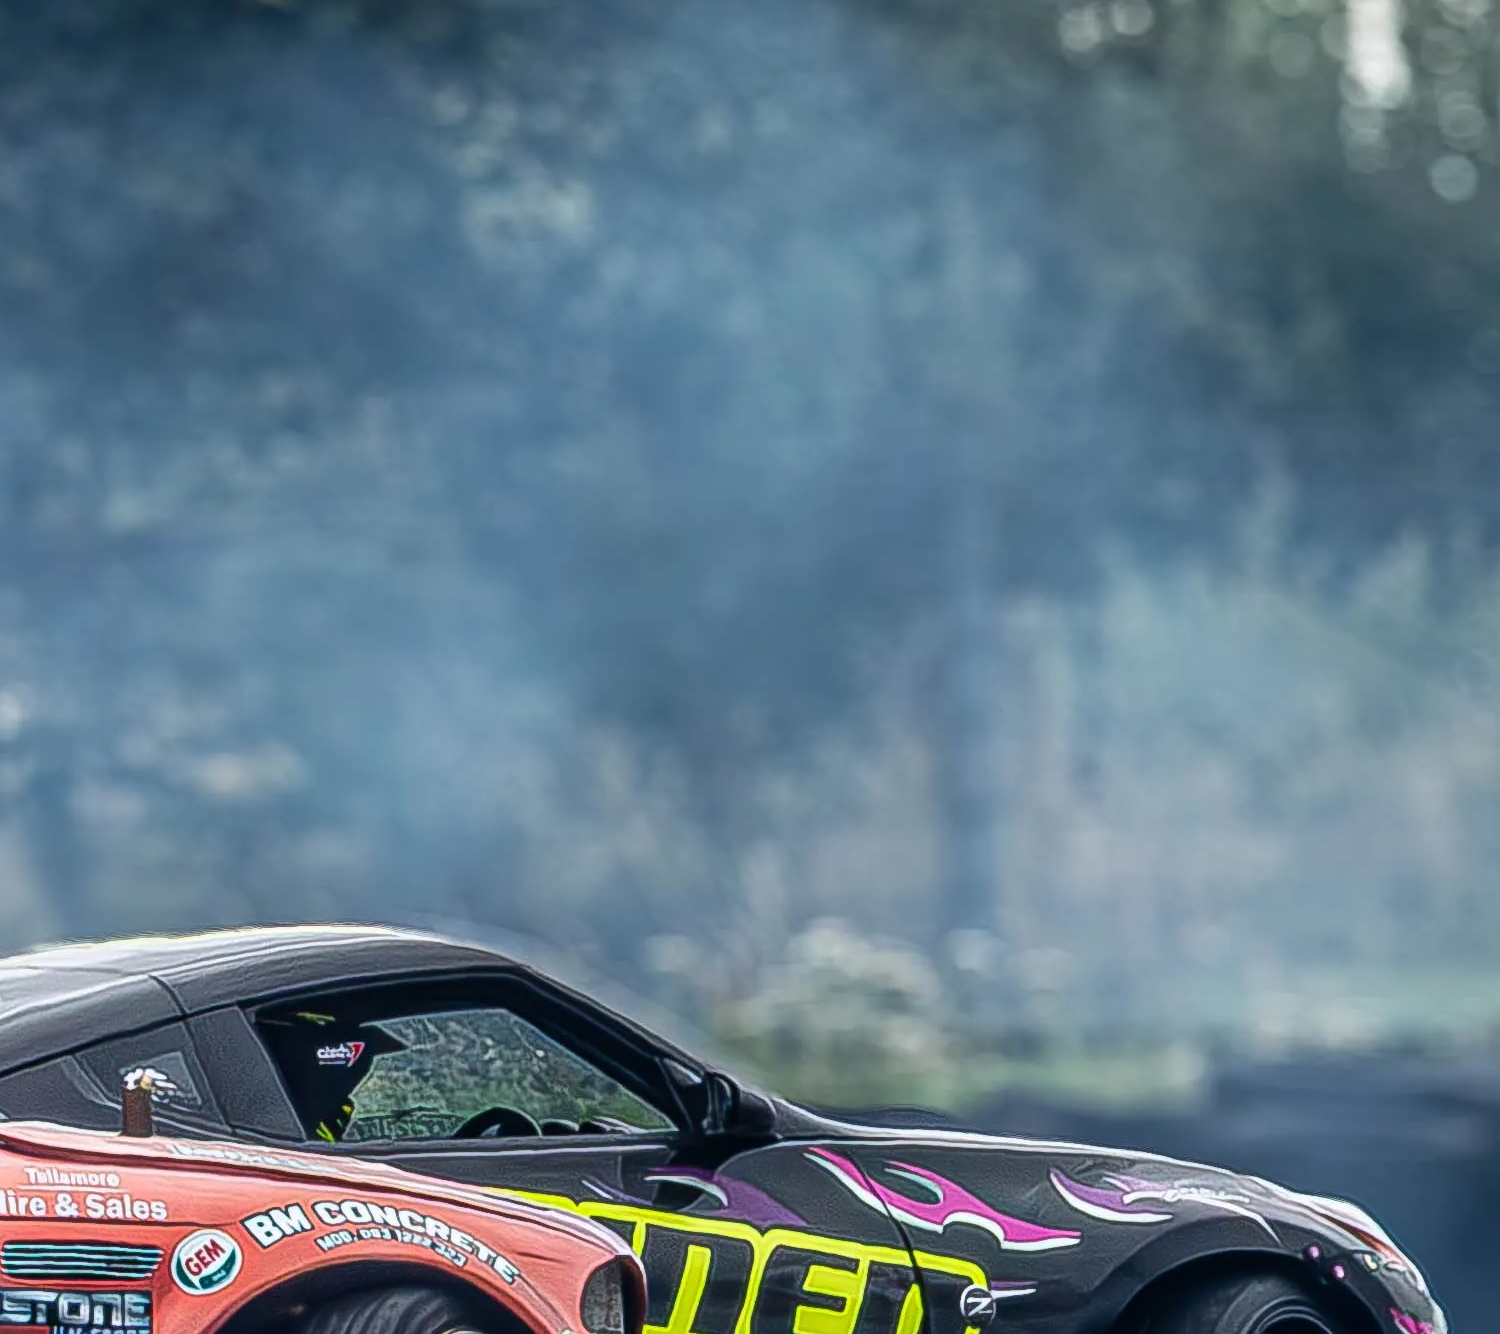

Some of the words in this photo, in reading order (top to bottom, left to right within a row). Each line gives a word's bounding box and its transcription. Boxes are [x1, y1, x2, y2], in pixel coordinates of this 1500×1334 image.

[54, 1192, 80, 1218] &
[85, 1193, 168, 1221] Sales
[184, 1238, 227, 1277] GEM
[240, 1203, 313, 1249] BM
[312, 1198, 521, 1285] CONCRETE
